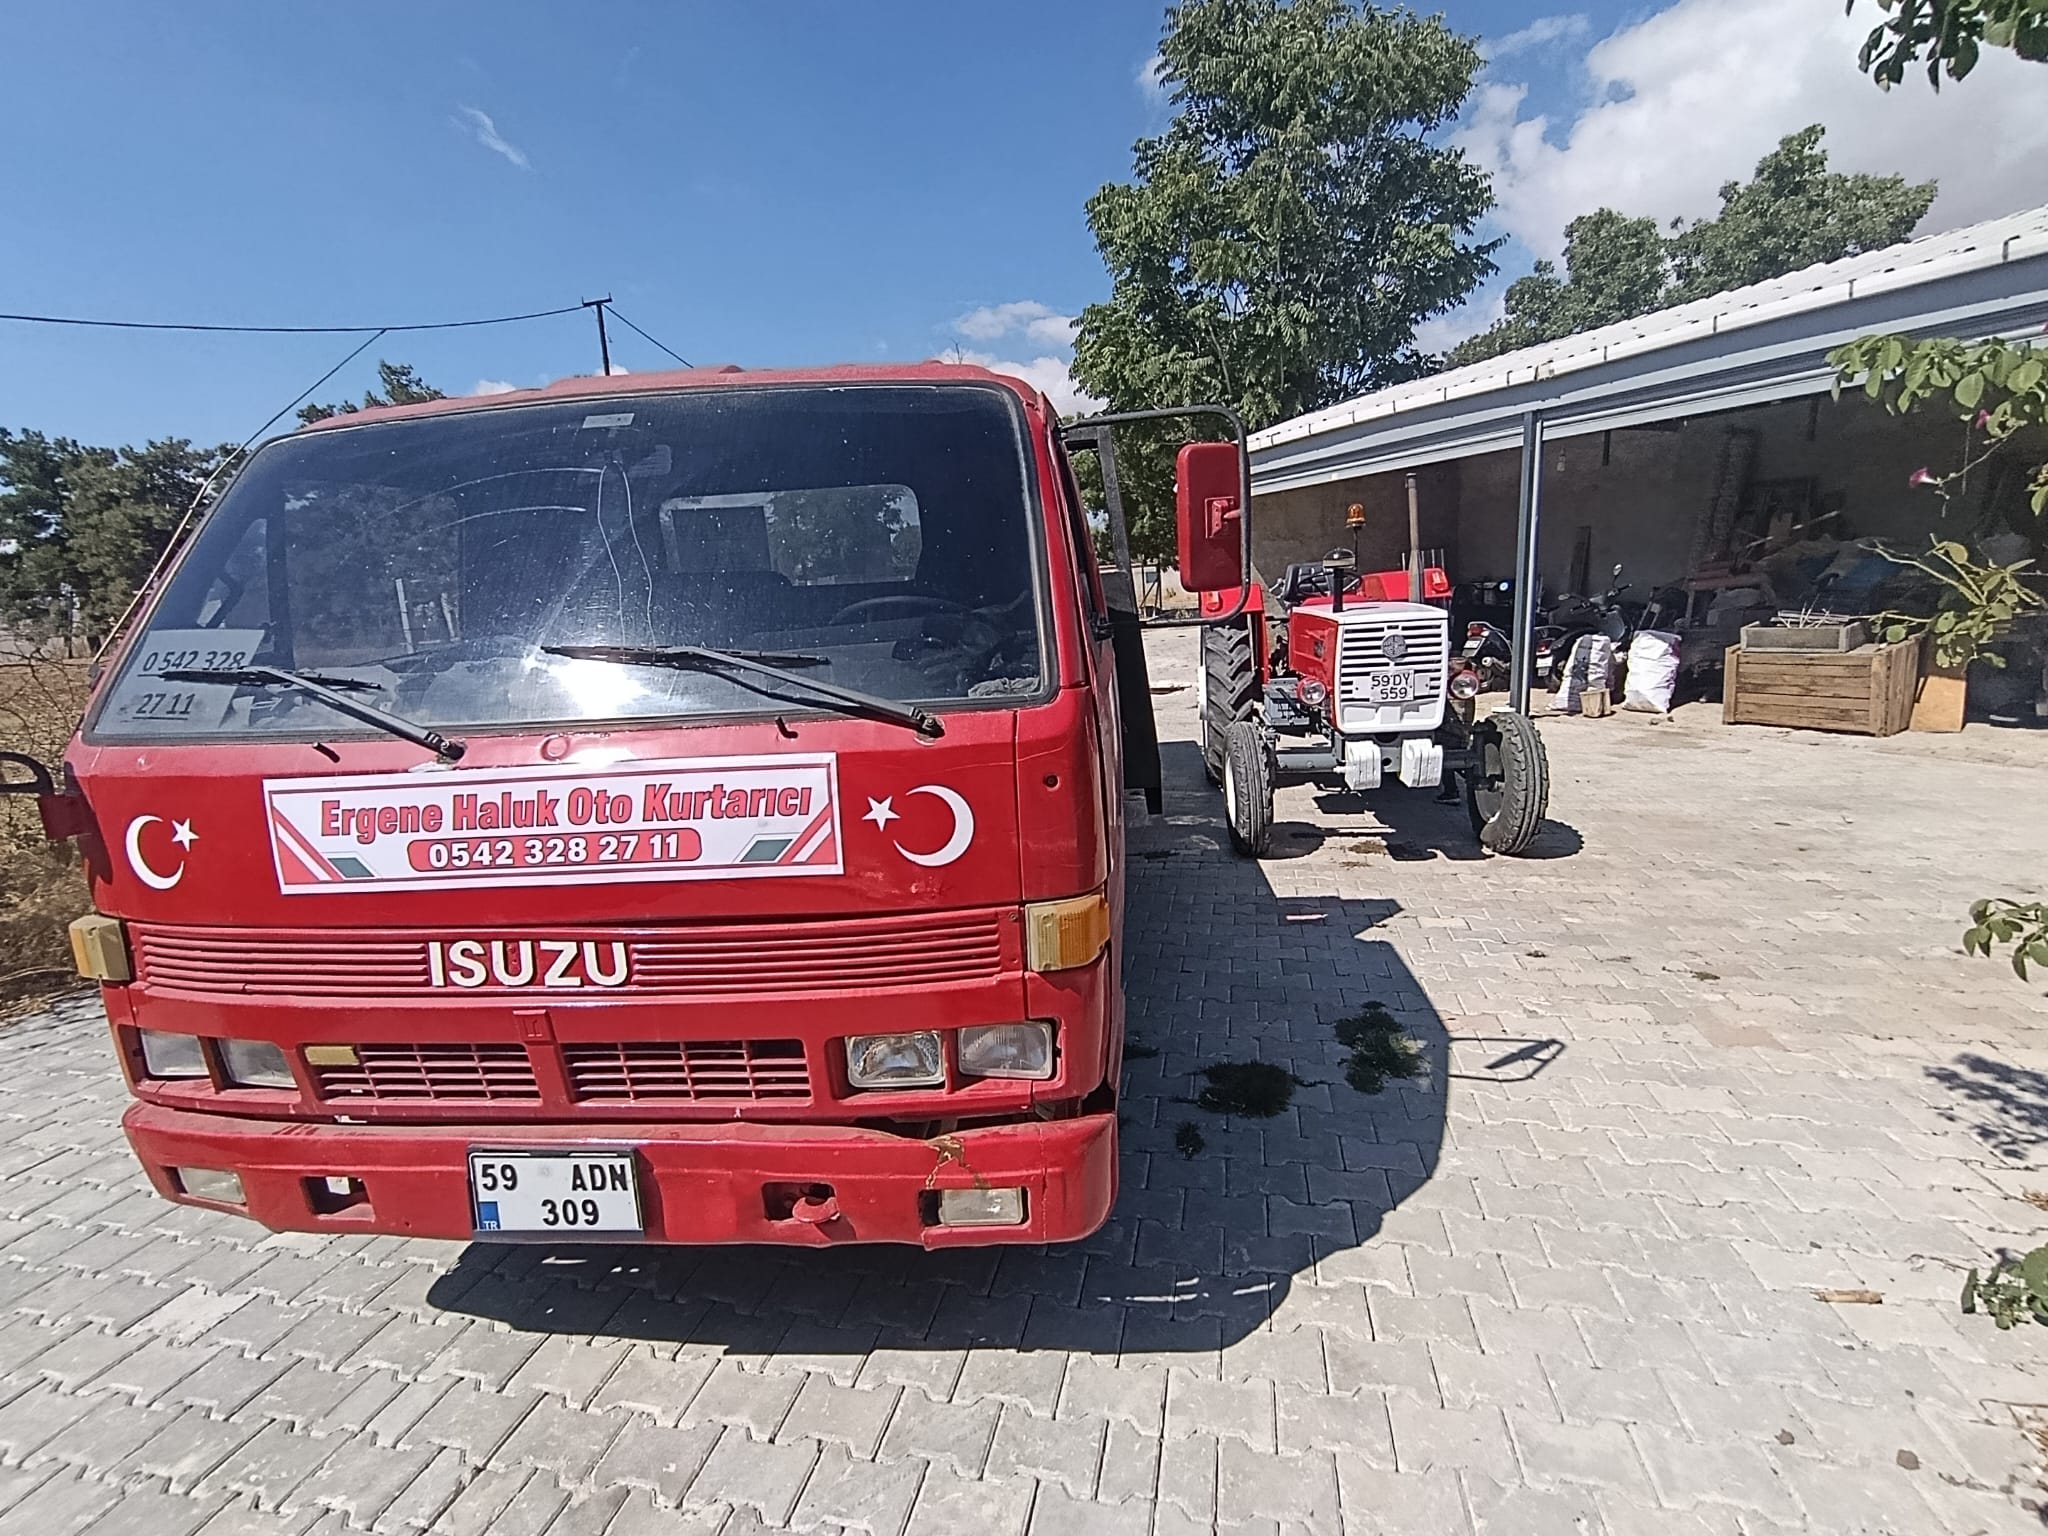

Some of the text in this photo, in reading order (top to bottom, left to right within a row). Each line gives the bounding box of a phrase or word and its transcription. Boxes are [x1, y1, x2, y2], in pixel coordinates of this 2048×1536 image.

[1380, 687, 1408, 700] 559
[321, 783, 812, 845] Ergene Haluk Oto Kurtarıcı
[429, 832, 679, 868] 0542 328 27 11
[428, 940, 629, 988] ISUZU
[481, 1163, 629, 1191] 59 ADN
[483, 1221, 498, 1229] TR
[541, 1199, 600, 1226] 309
